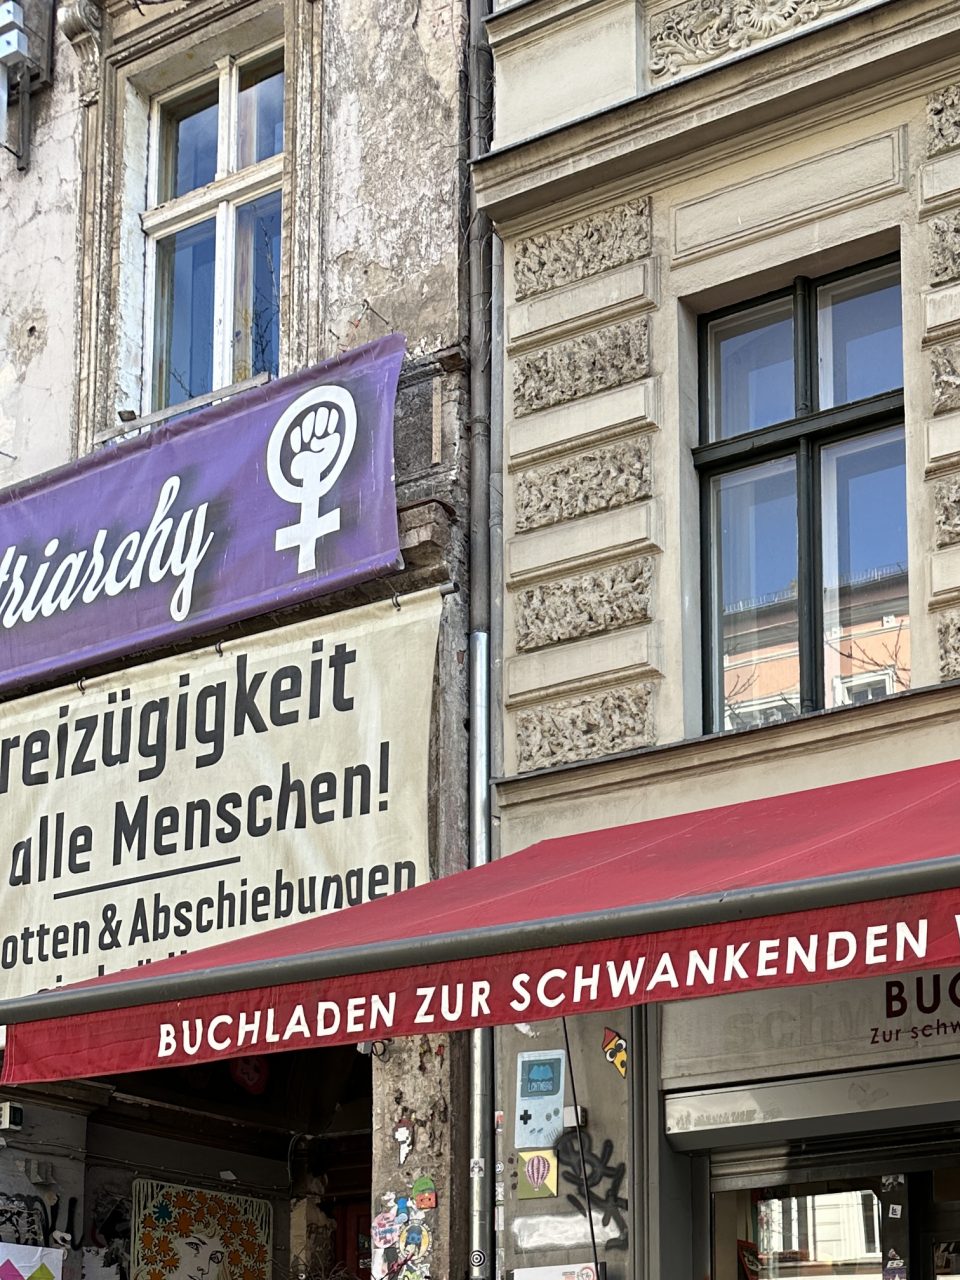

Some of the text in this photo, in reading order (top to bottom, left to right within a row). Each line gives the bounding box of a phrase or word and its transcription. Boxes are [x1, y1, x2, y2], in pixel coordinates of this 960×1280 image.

[0, 640, 357, 794] reizügigkeit
[9, 741, 391, 887] alle Menschen!
[2, 860, 417, 969] otten & Abschiebungen
[157, 992, 397, 1058] BUCHLADEN
[414, 980, 491, 1025] ZUR
[510, 918, 929, 1012] SCHWANKENDEN
[870, 1026, 901, 1045] Zur
